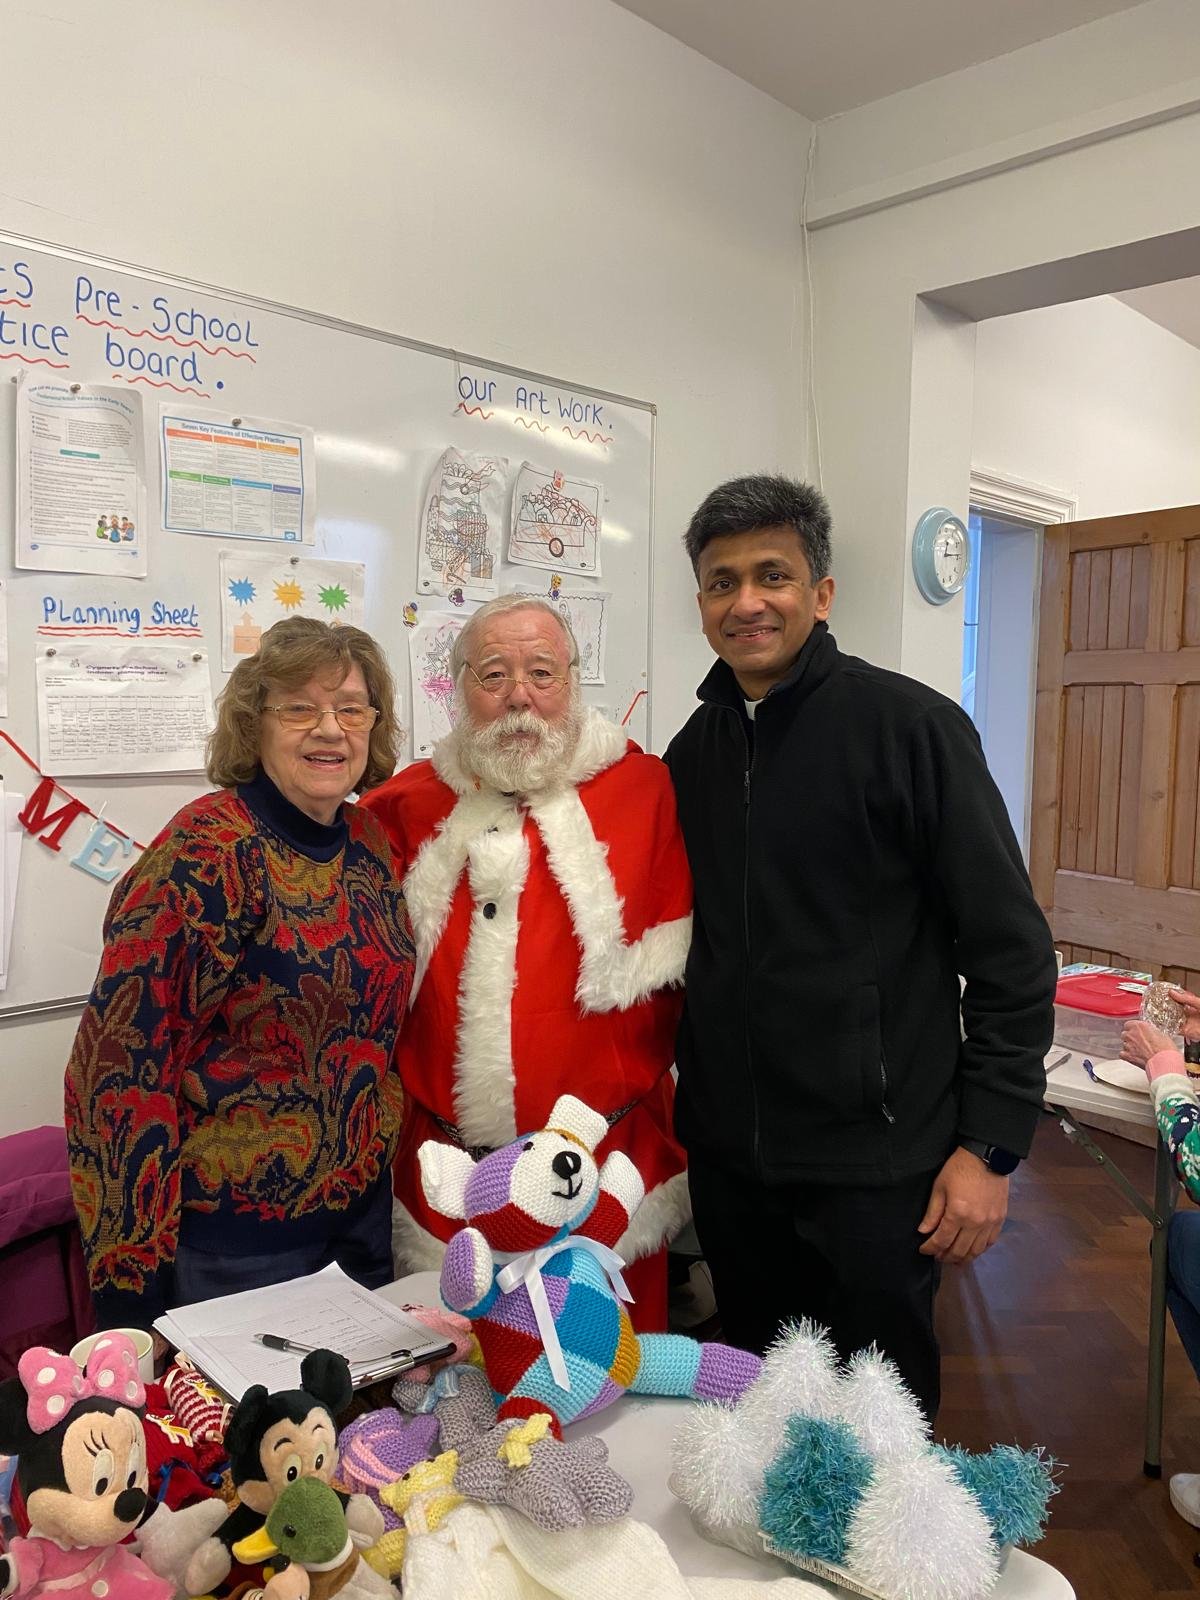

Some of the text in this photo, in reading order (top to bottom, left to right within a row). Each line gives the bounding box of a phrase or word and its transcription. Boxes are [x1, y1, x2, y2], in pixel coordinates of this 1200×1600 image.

[516, 387, 550, 415] Art
[182, 422, 199, 431] Seven
[199, 425, 209, 434] Key
[264, 434, 286, 444] Practice
[151, 601, 198, 628] Sheet
